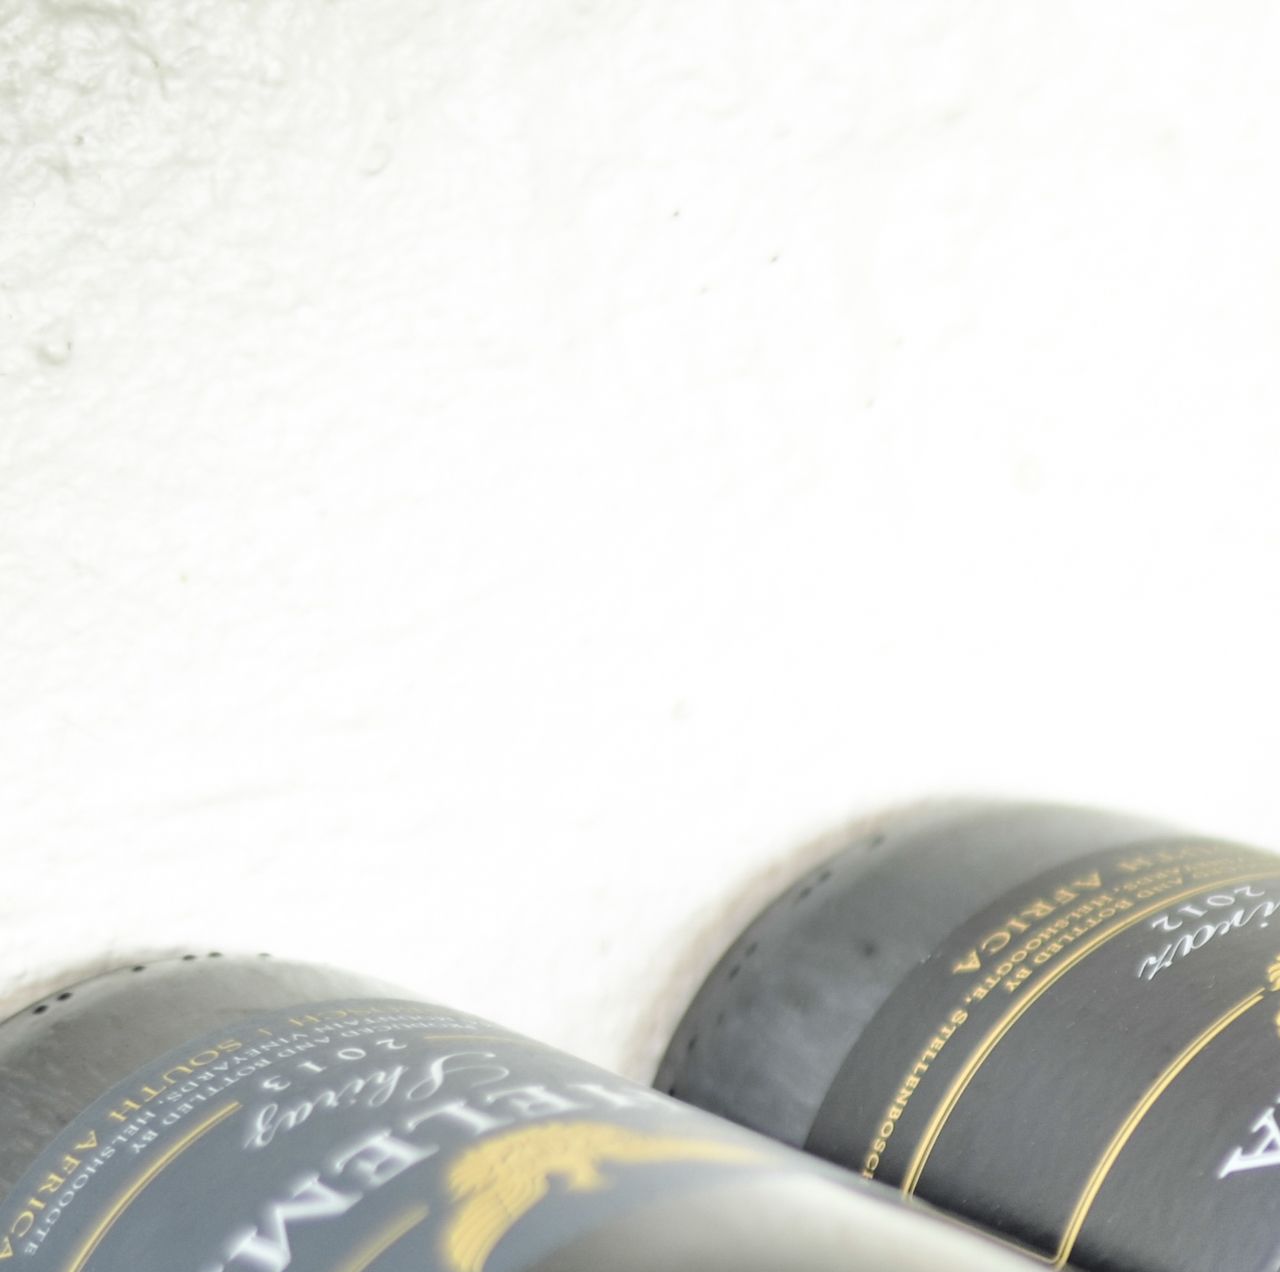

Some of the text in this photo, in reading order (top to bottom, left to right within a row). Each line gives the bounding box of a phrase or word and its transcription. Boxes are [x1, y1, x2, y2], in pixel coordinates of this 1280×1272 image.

[953, 870, 1102, 975] AFRICA
[1033, 899, 1134, 965] BOTTLED
[1151, 885, 1266, 932] 2012
[1004, 966, 1033, 993] BY
[260, 1037, 408, 1092] 2013
[277, 1035, 331, 1058] AND
[109, 1039, 243, 1123] SOUTH
[162, 1058, 273, 1126] BOTTLED
[244, 1050, 510, 1149] Shiraz
[131, 1130, 159, 1154] BY
